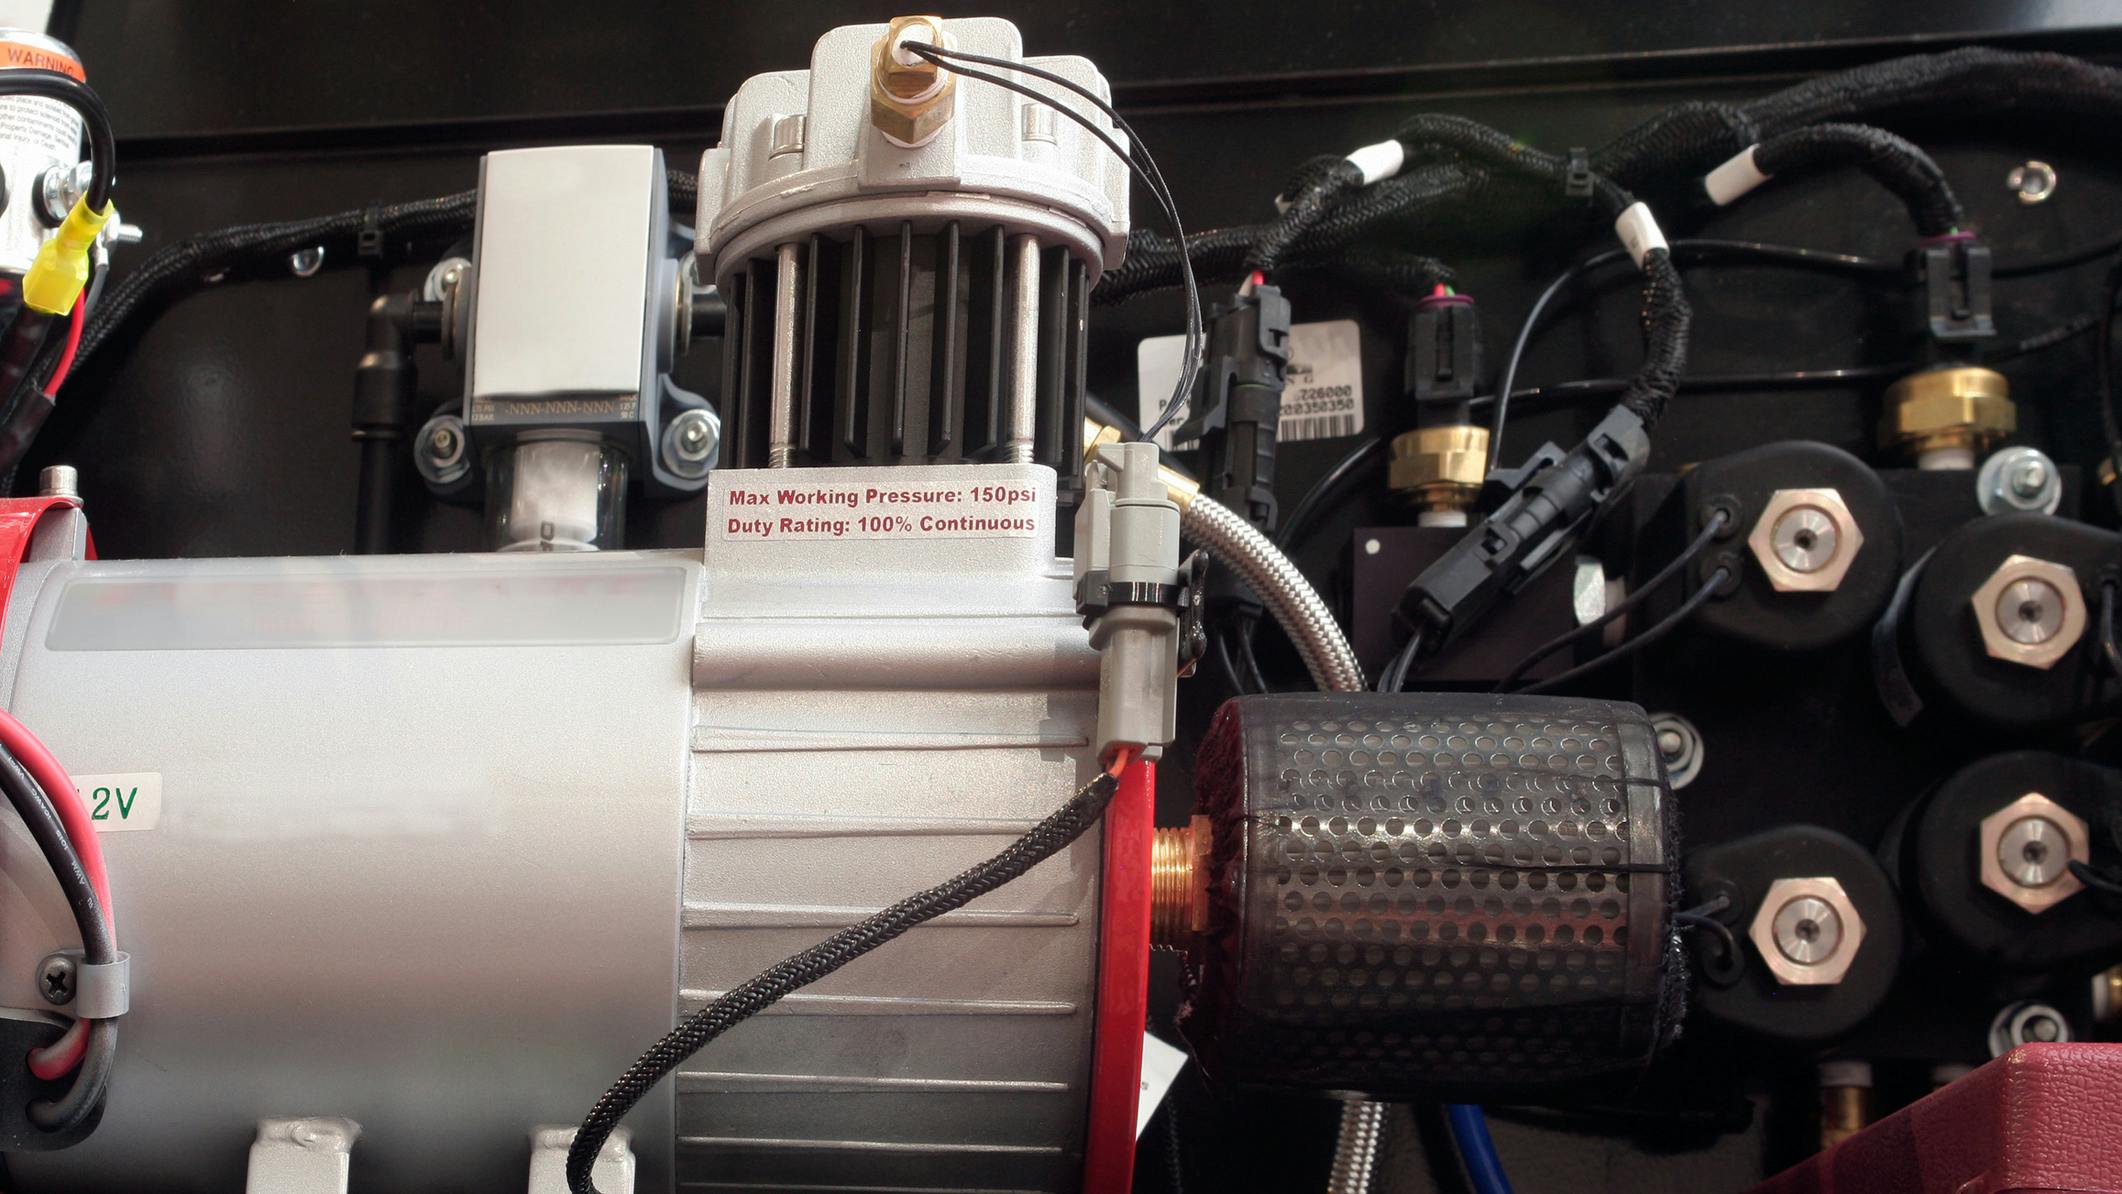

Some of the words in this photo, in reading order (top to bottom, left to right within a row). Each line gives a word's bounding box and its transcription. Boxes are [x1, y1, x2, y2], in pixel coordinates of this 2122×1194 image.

[8, 47, 74, 76] WARNING
[729, 490, 770, 505] Max
[777, 489, 858, 507] Working
[866, 488, 962, 504] Pressure:
[970, 487, 1036, 506] 150psi
[728, 518, 773, 537] Duty
[780, 517, 850, 536] Rating:
[858, 516, 913, 532] 100%
[920, 515, 1035, 531] Continuous
